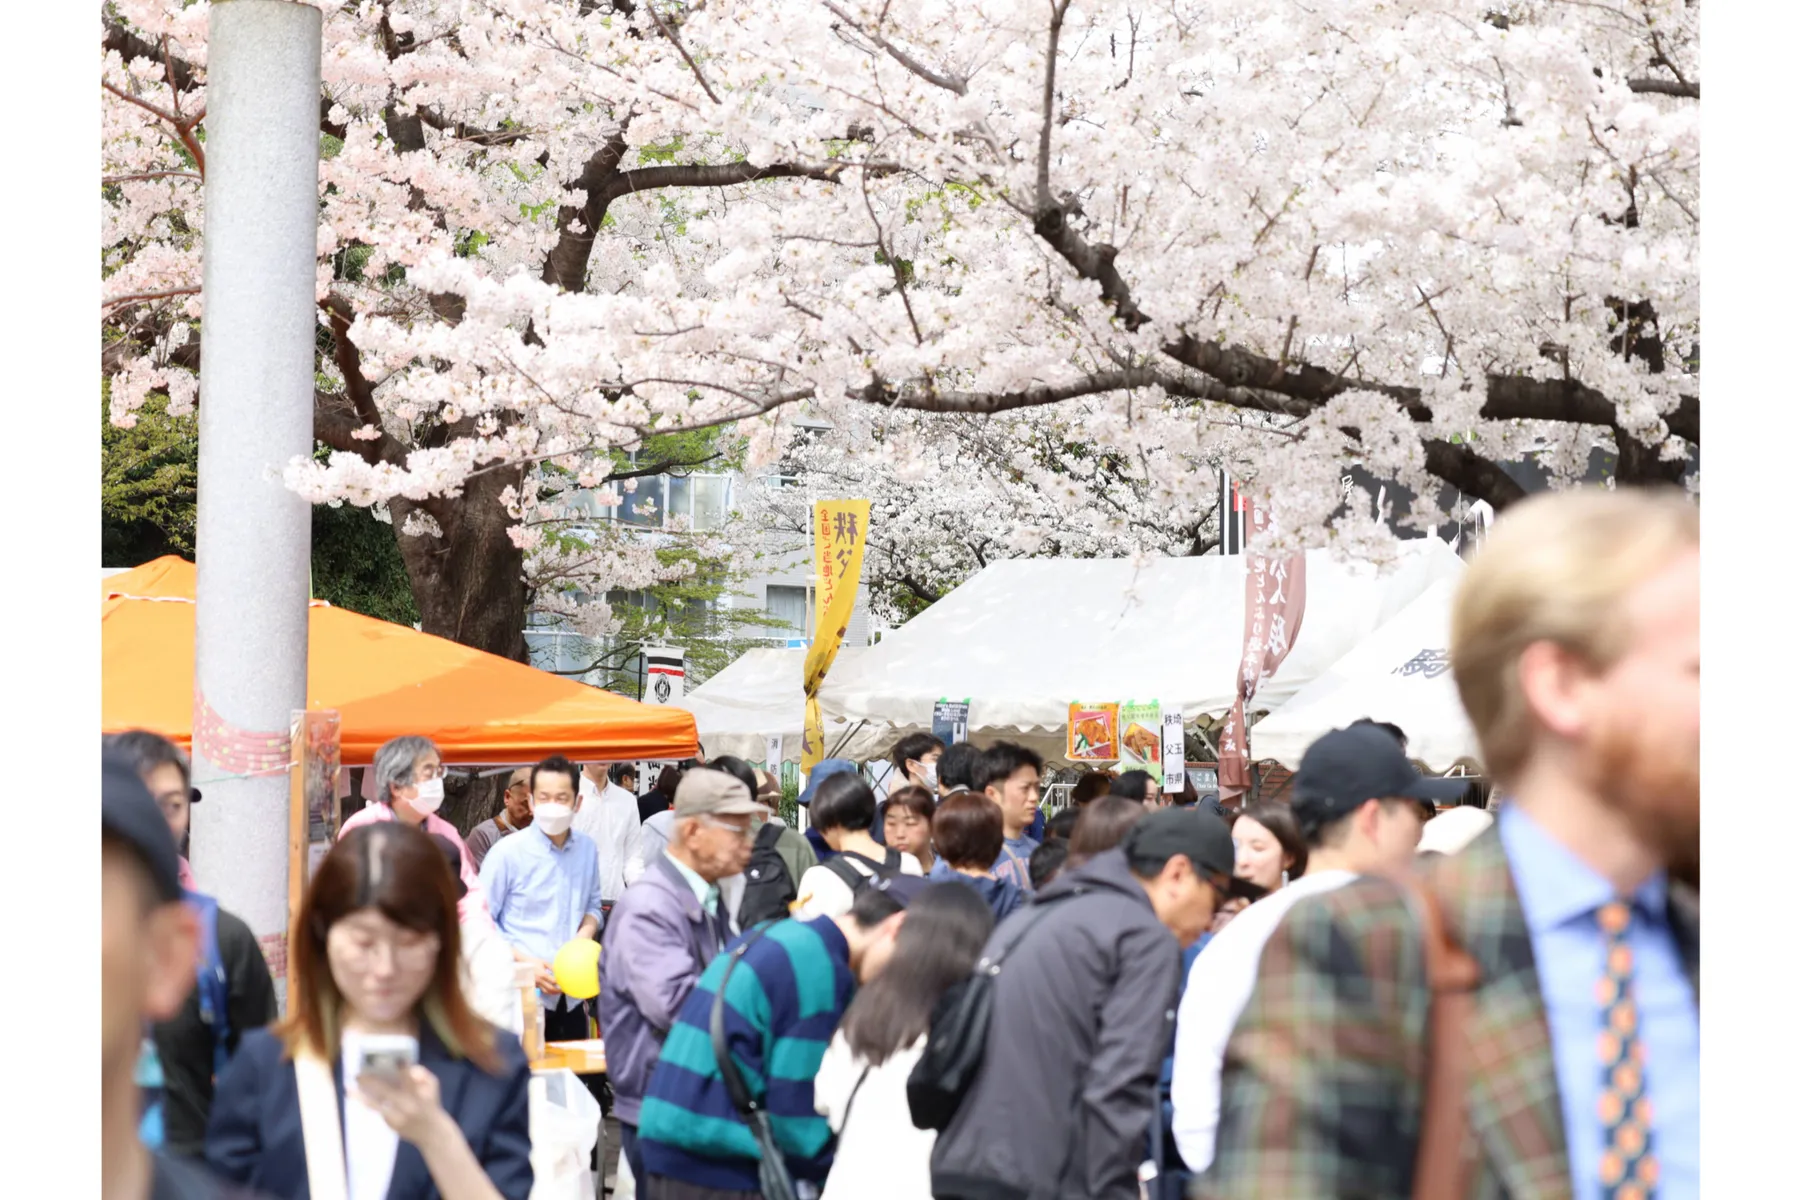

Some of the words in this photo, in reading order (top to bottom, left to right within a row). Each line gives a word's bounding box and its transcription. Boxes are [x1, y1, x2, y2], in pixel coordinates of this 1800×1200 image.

[1164, 714, 1174, 785] 秩父市
[1173, 713, 1183, 785] 埼玉県
